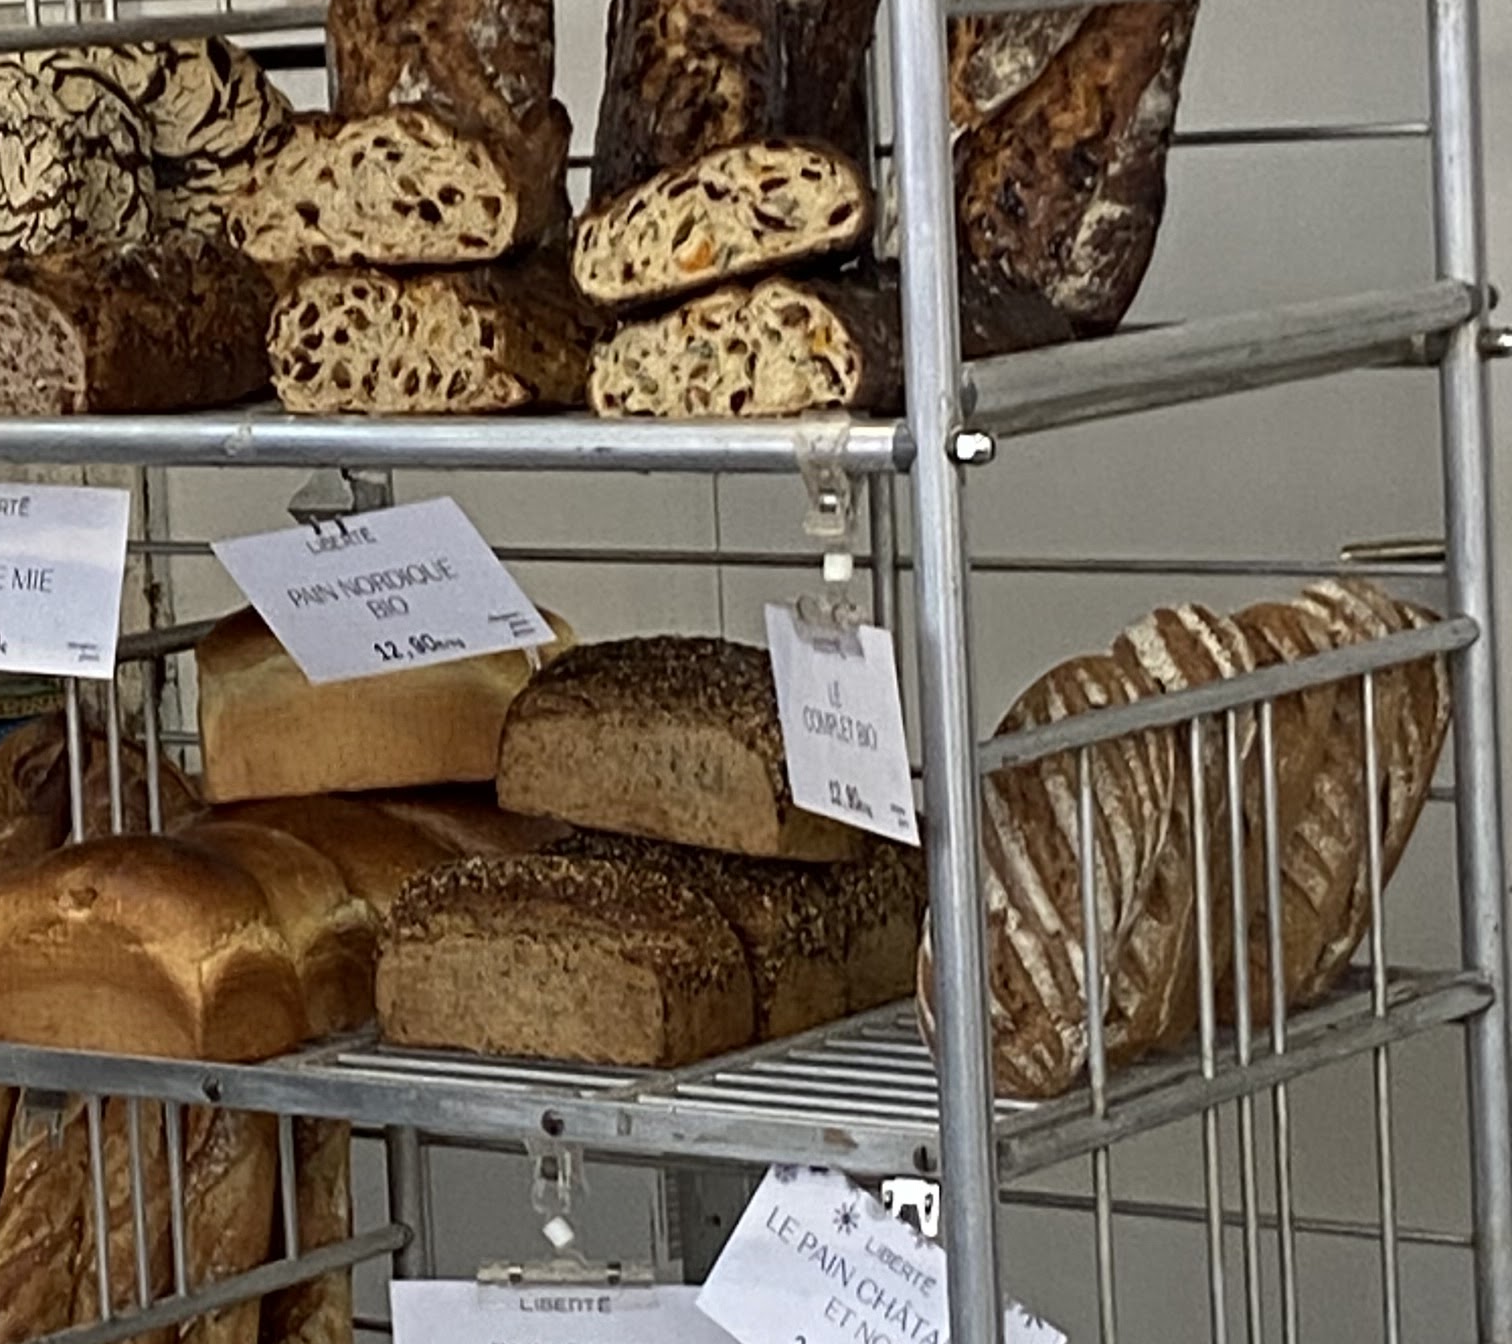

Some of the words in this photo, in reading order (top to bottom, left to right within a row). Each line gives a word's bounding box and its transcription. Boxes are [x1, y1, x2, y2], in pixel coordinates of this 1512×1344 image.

[11, 568, 55, 594] MIE
[287, 582, 340, 609] PAIN
[339, 558, 459, 598] NORDIQUE
[366, 595, 410, 621] BIO
[765, 1206, 800, 1244] LE
[796, 1231, 858, 1289] PAIN
[864, 1235, 938, 1297] LIBERTÉ
[519, 1295, 613, 1314] LIBERTÉ
[824, 1295, 856, 1329] ET
